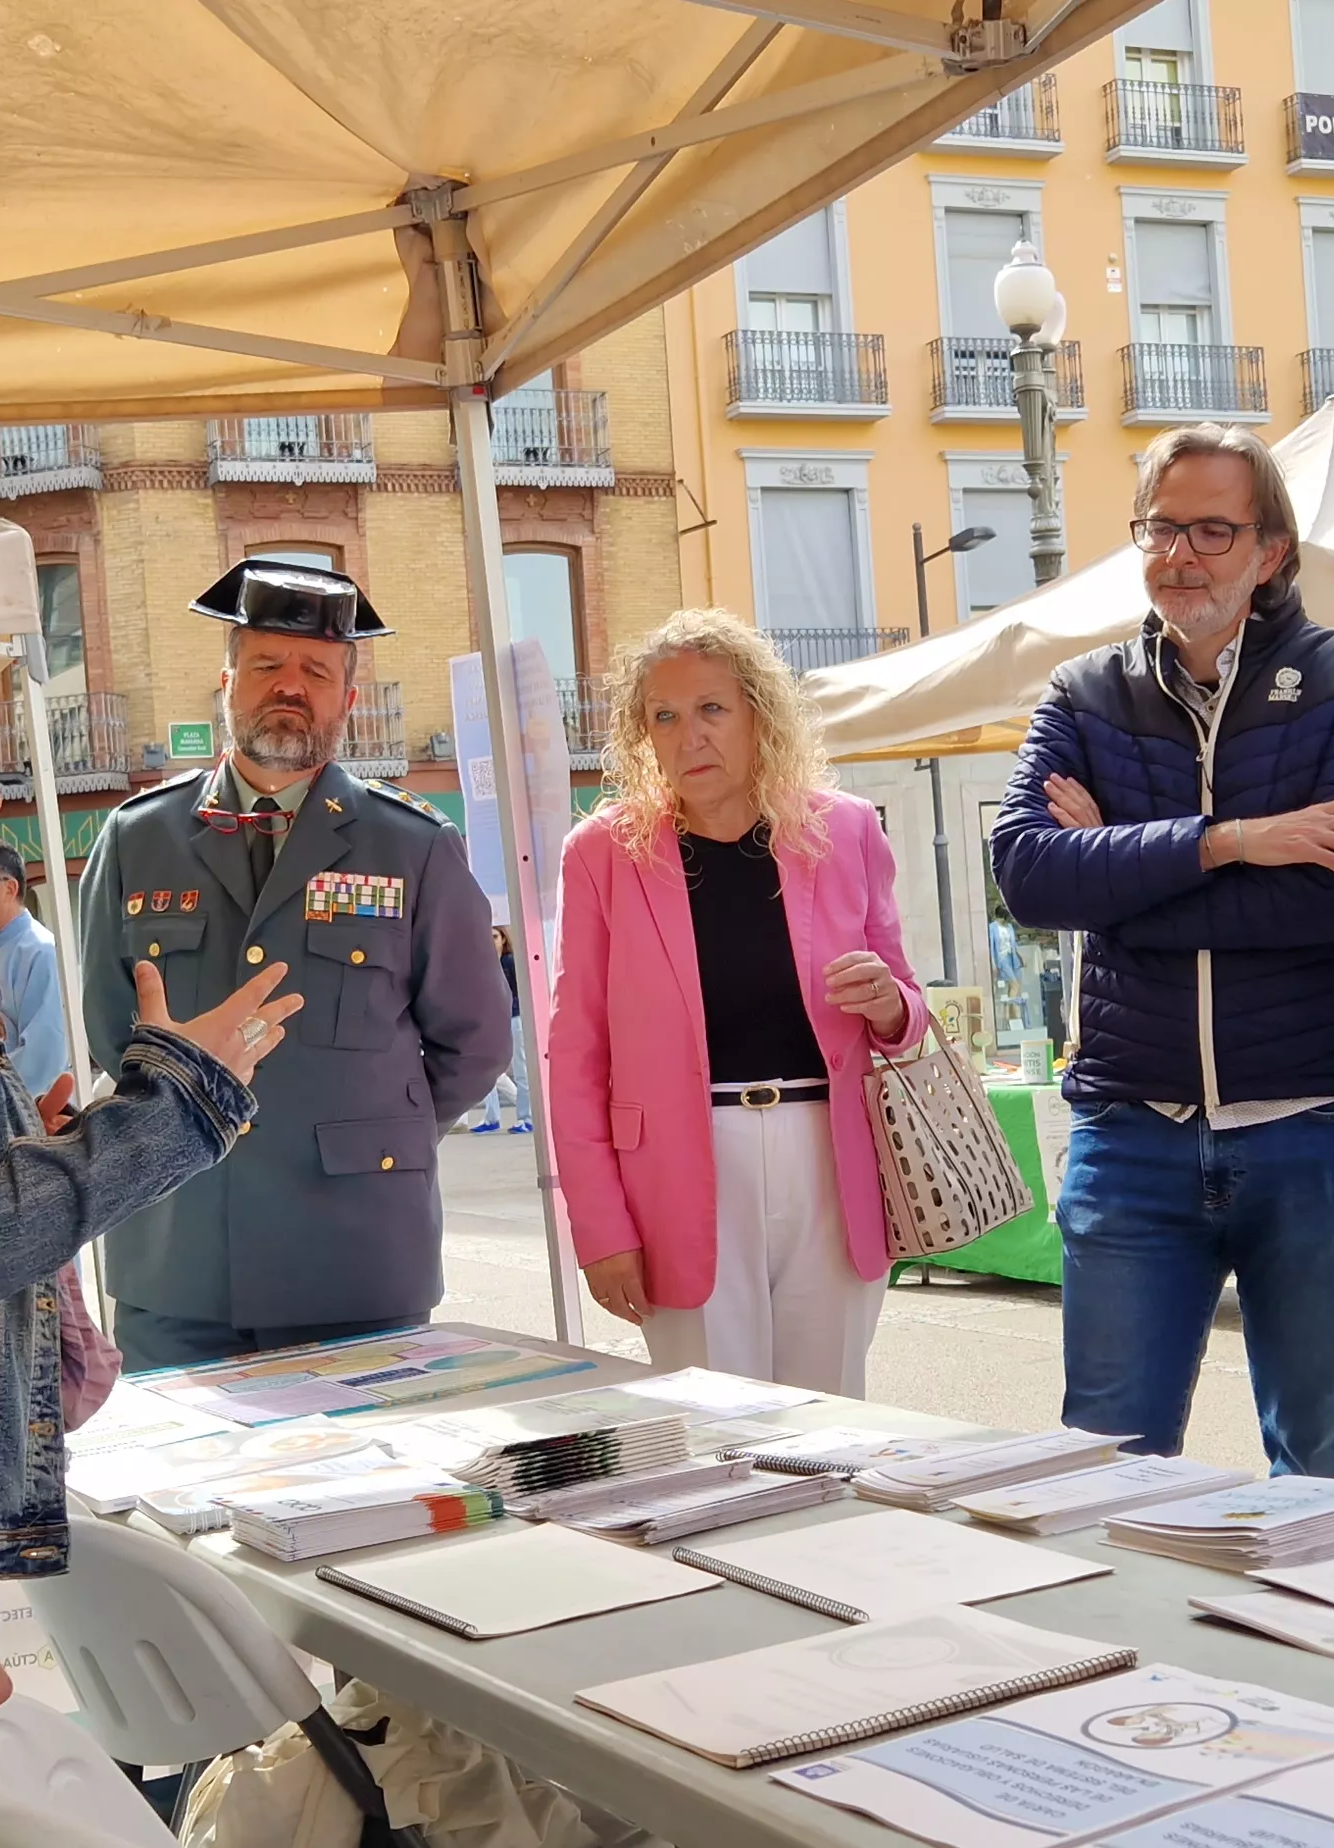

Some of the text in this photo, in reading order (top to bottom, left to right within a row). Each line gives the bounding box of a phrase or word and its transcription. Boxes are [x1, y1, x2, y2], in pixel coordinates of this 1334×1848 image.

[906, 1746, 1002, 1781] OBLIGACIONES
[979, 1744, 1027, 1760] SALUD
[987, 1760, 1060, 1787] PERSONAS
[1011, 1782, 1091, 1811] DERECHOS
[1059, 1784, 1093, 1797] LAS
[1090, 1792, 1114, 1802] DE
[995, 1792, 1066, 1818] CARTA DE
